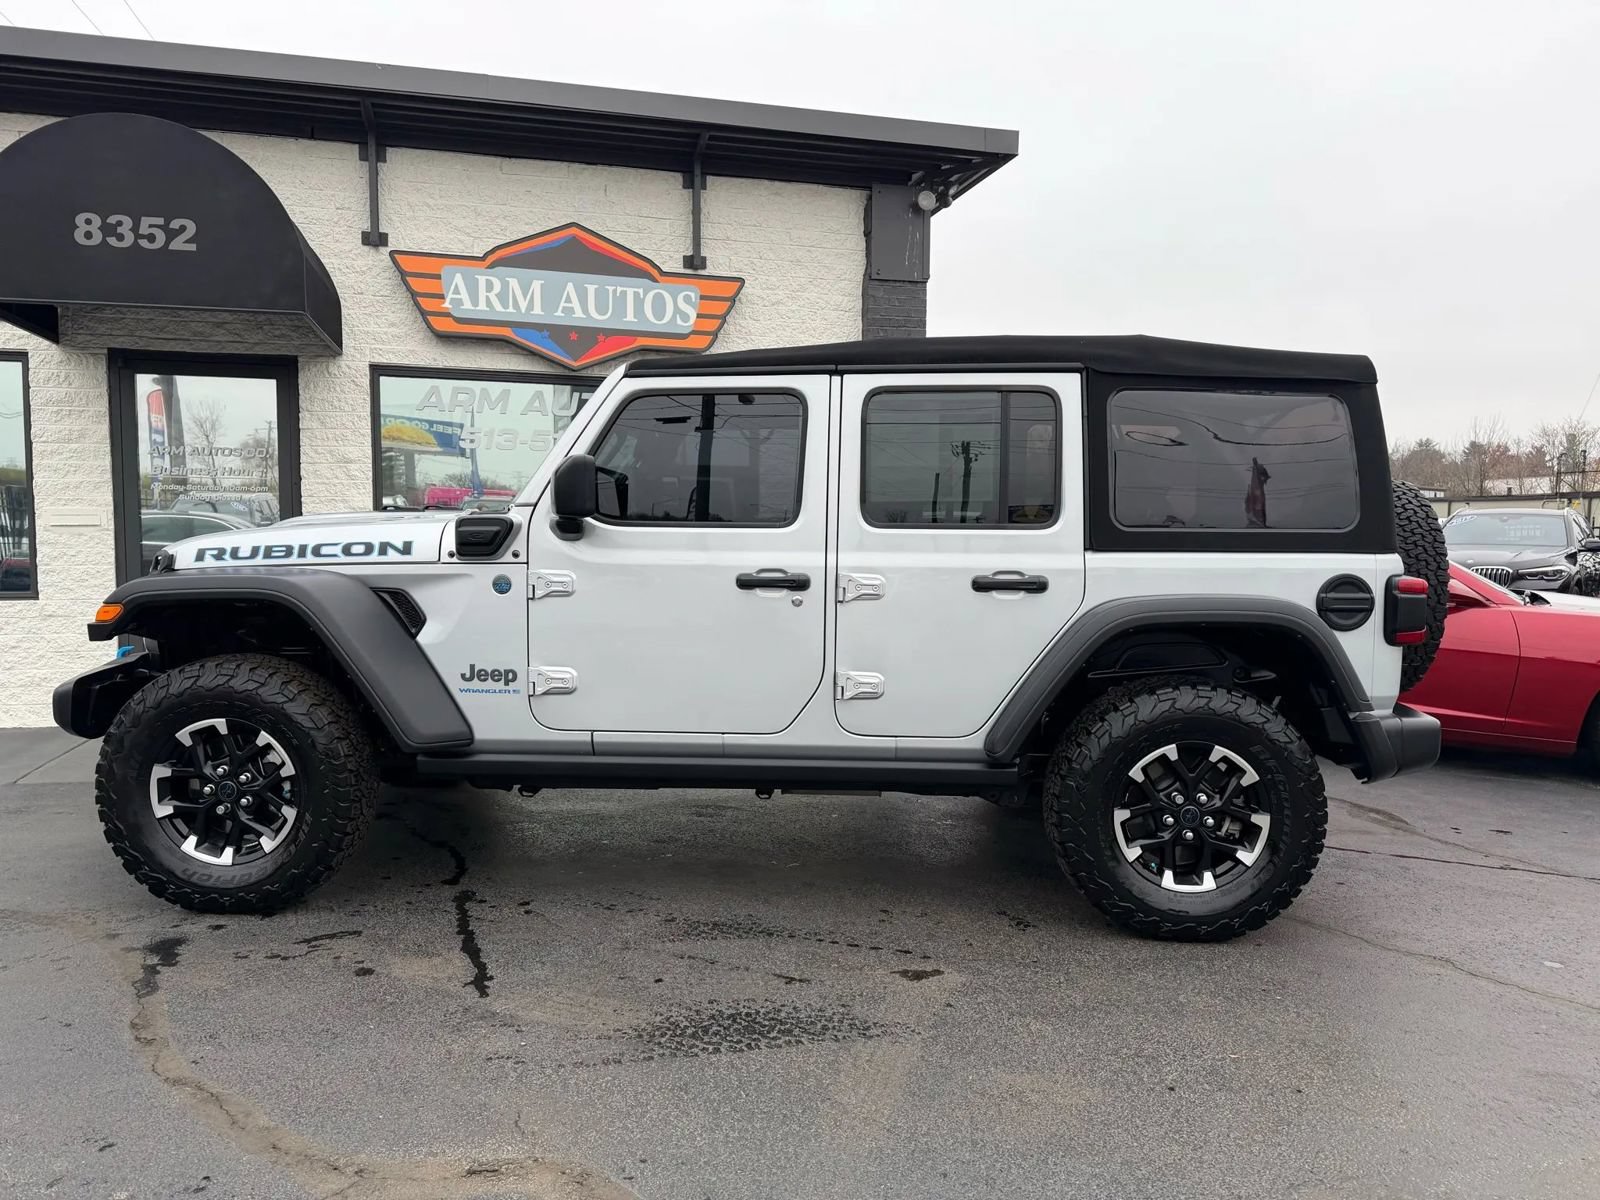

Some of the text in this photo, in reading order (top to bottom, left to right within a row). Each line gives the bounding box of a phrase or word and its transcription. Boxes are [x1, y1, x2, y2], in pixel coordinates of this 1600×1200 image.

[73, 211, 197, 251] 8352
[441, 272, 697, 327] ARM AUTOS
[416, 385, 595, 417] ARM AU
[148, 446, 185, 457] ARM
[187, 446, 243, 458] AUTOS
[151, 464, 219, 477] Business
[194, 540, 413, 563] RUBICON
[460, 664, 518, 686] Jeep
[458, 687, 511, 695] WRANGLER
